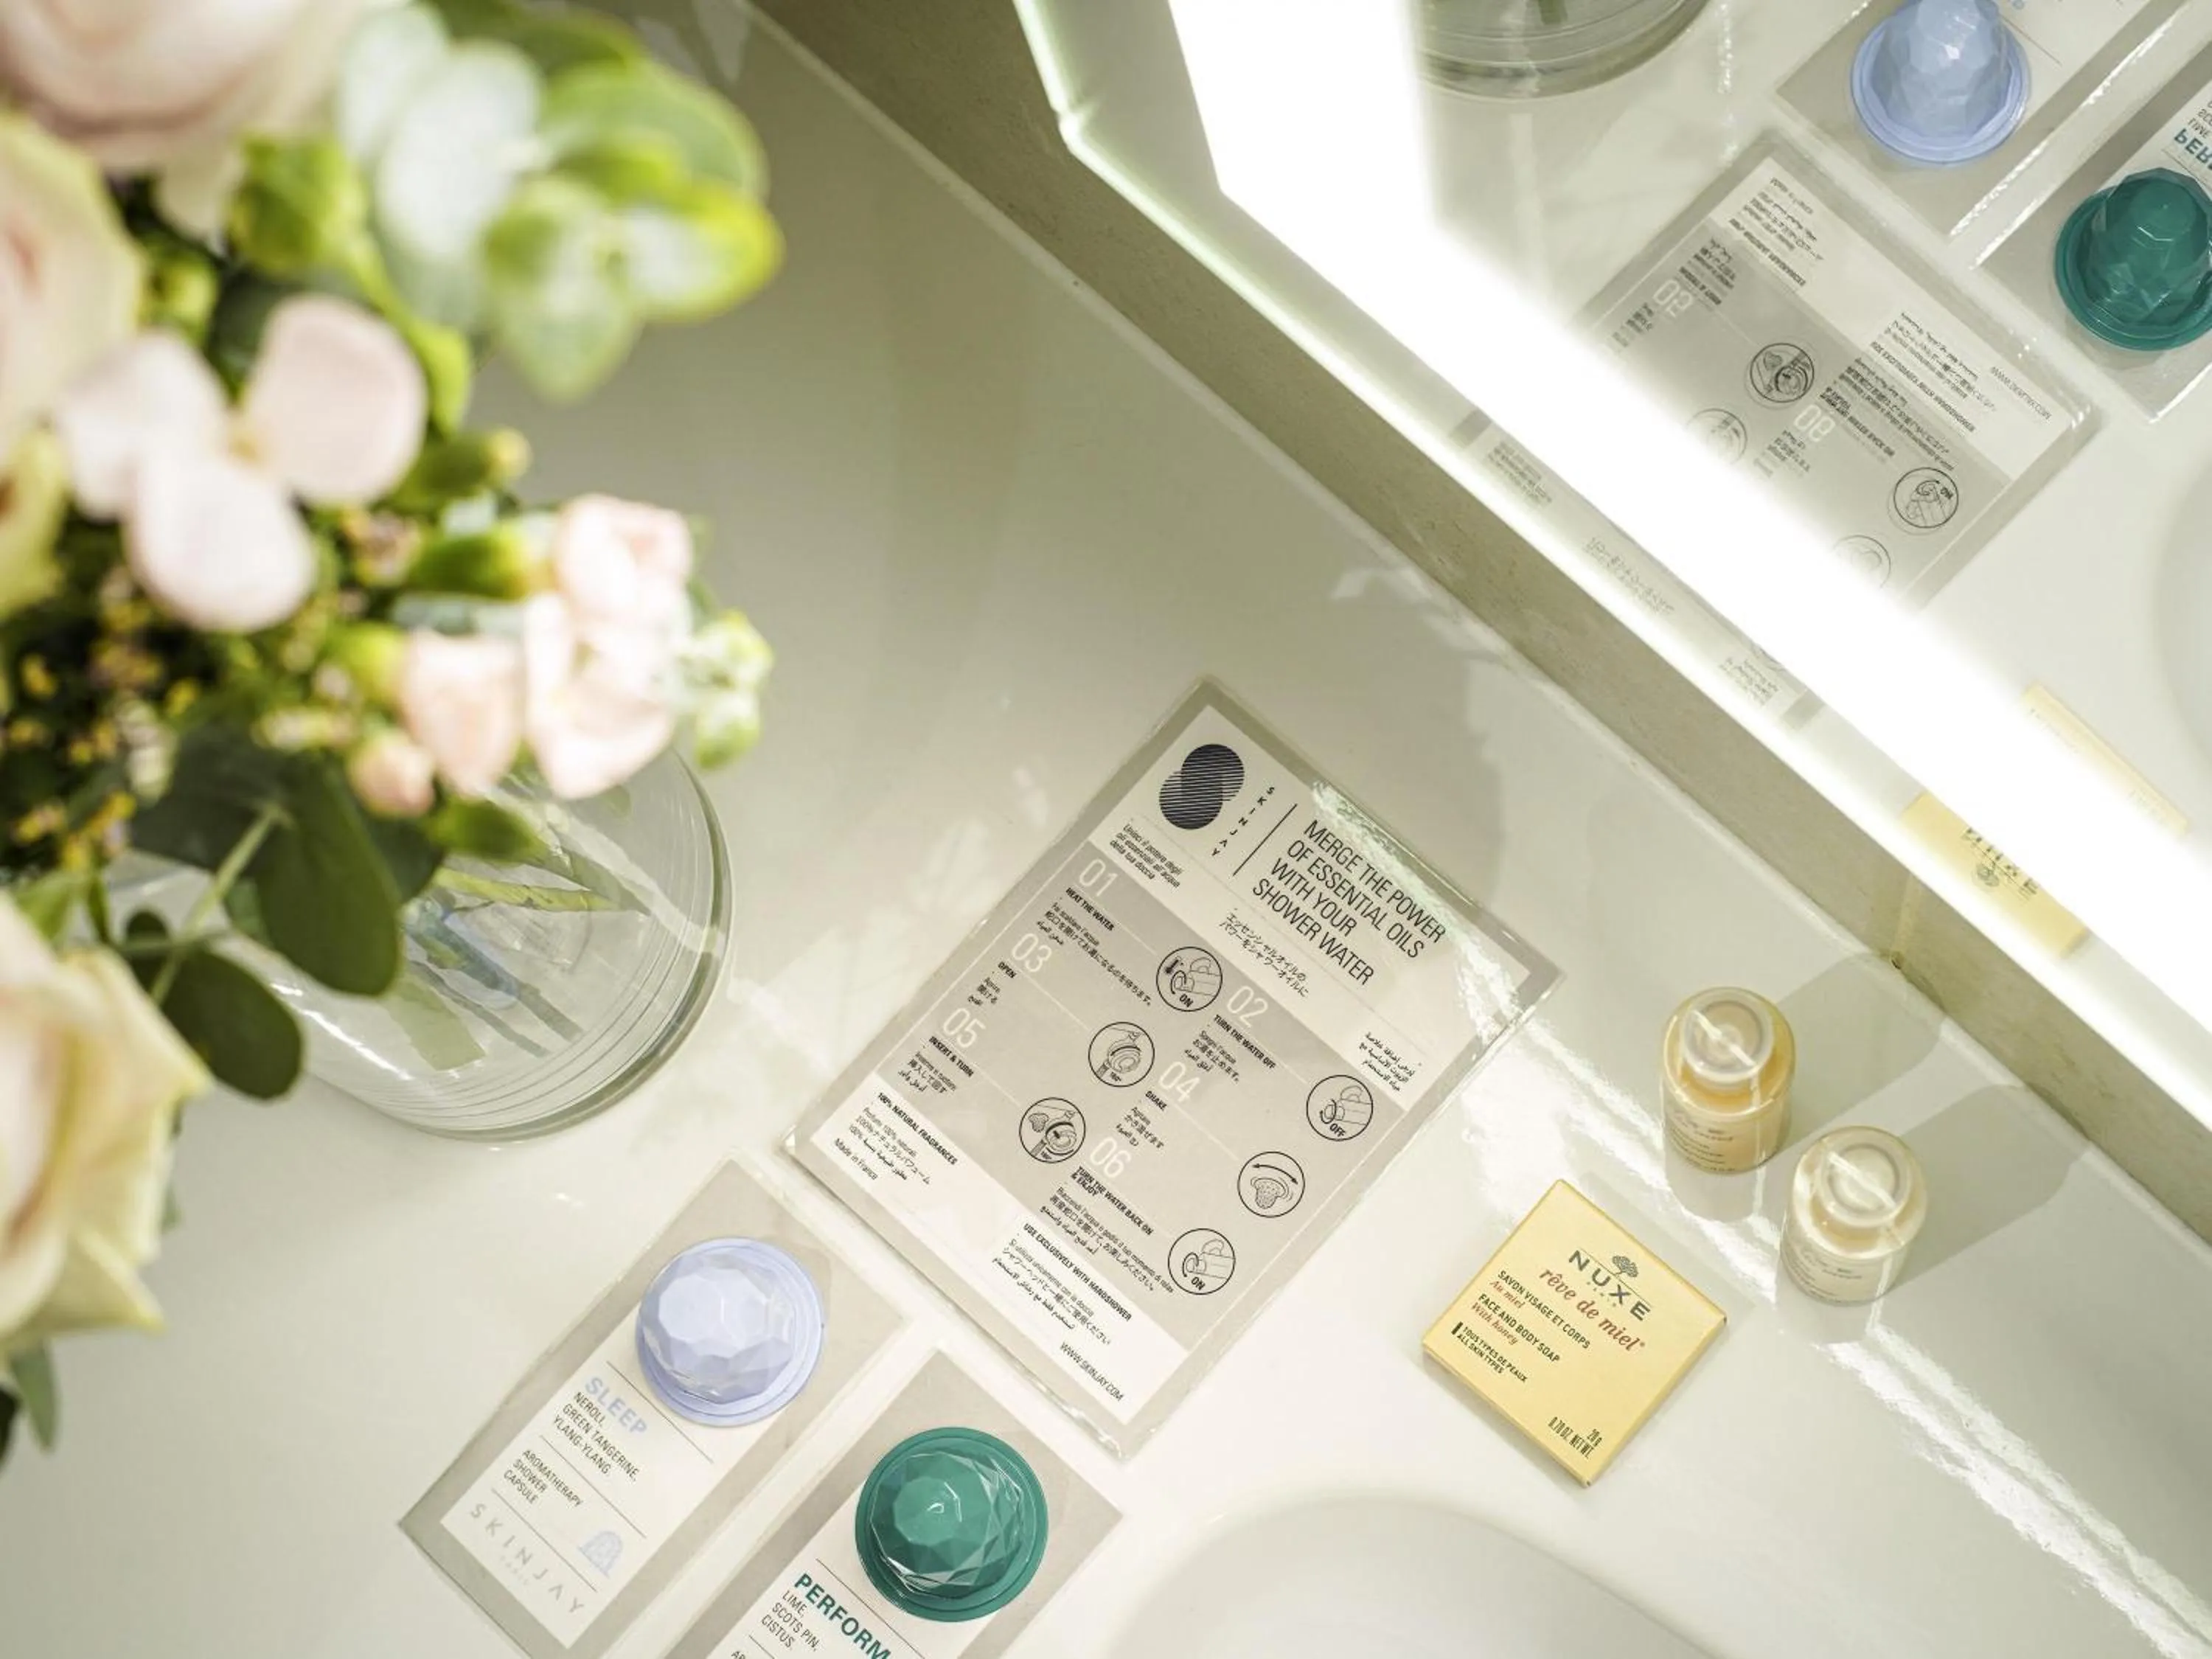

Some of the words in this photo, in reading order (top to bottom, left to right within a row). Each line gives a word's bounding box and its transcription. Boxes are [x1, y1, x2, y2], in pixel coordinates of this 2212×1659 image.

[1209, 785, 1277, 858] SKINJAY
[1076, 856, 1119, 897] 01
[1267, 858, 1315, 900] WITH
[1309, 891, 1357, 936] YOUR
[1285, 838, 1314, 865] OF
[1307, 856, 1391, 931] ESSENTIAL
[1385, 922, 1425, 959] OILS
[1303, 819, 1362, 872] MERGE
[1354, 863, 1393, 898] THE
[1385, 888, 1447, 943] POWER
[1064, 886, 1082, 903] HEAT
[1079, 900, 1095, 914] THE
[1091, 910, 1115, 931] WATER
[1251, 877, 1323, 941] SHOWER
[1315, 931, 1375, 986] WATER
[997, 961, 1016, 978] OPEN
[1009, 930, 1054, 975] 03
[1178, 993, 1194, 1007] ON
[1223, 983, 1270, 1028] 02
[939, 1004, 987, 1051] 05
[1212, 1014, 1232, 1032] TURN
[1229, 1029, 1245, 1043] THE
[1240, 1038, 1265, 1060] WATER
[1261, 1056, 1276, 1070] OFF
[928, 1035, 952, 1057] INSERT
[949, 1054, 958, 1062] &
[955, 1059, 974, 1077] TURN
[1144, 1090, 1167, 1111] SHAKE
[1156, 1058, 1203, 1104] 04
[876, 1091, 894, 1108] 100%
[891, 1105, 920, 1132] NATURAL
[917, 1128, 958, 1166] FRAGRANCES
[1328, 1121, 1346, 1139] OFF
[832, 1138, 853, 1157] Made
[849, 1153, 860, 1164] in
[855, 1158, 879, 1180] France
[1086, 1134, 1134, 1181] 06
[1070, 1172, 1079, 1180] &
[1076, 1176, 1098, 1197] ENJOY
[1076, 1166, 1095, 1183] TURN
[1092, 1180, 1107, 1194] THE
[1103, 1190, 1127, 1212] WATER
[1124, 1208, 1144, 1227] BACK
[1141, 1223, 1153, 1236] ON
[1023, 1222, 1039, 1237] USE
[1034, 1233, 1074, 1270] EXCLUSIVELY
[1071, 1265, 1091, 1284] WITH
[1087, 1280, 1133, 1322] HANDSHOWER
[1190, 1276, 1206, 1291] ON
[1489, 1277, 1506, 1293] Au
[1502, 1289, 1525, 1310] miel
[1538, 1264, 1580, 1303] rêve
[1575, 1295, 1603, 1322] de
[1567, 1248, 1651, 1322] NUXE
[1470, 1301, 1494, 1324] With
[1489, 1318, 1520, 1346] honey
[1478, 1292, 1501, 1314] FACE
[1498, 1309, 1517, 1328] AND
[1514, 1323, 1540, 1347] BODY
[1535, 1341, 1561, 1365] SOAP
[1497, 1269, 1526, 1295] SAVON
[1522, 1290, 1554, 1319] VISAGE
[1551, 1314, 1565, 1328] ET
[1560, 1322, 1591, 1350] CORPS
[1058, 1340, 1124, 1402] WWW.SKINJAY.COM
[1456, 1332, 1470, 1345] ALL
[1468, 1342, 1485, 1358] SKIN
[1482, 1354, 1504, 1374] TYPES
[1462, 1326, 1480, 1342] TOUS
[1477, 1338, 1499, 1358] TYPES
[1496, 1355, 1508, 1366] DE
[1504, 1362, 1527, 1383] PEAUX
[583, 1374, 650, 1441] SLEEP
[561, 1402, 594, 1434] GREEN
[589, 1429, 641, 1482] TANGERINE,
[501, 1467, 539, 1505] CAPSULE
[512, 1458, 548, 1494] SHOWER
[521, 1447, 582, 1509] AROMATHERAPY
[468, 1500, 585, 1618] SKINJAY
[773, 1602, 804, 1633] SCOTS
[800, 1628, 822, 1652] PIN,
[782, 1590, 807, 1618] LIME,
[795, 1573, 891, 1659] PERFORM
